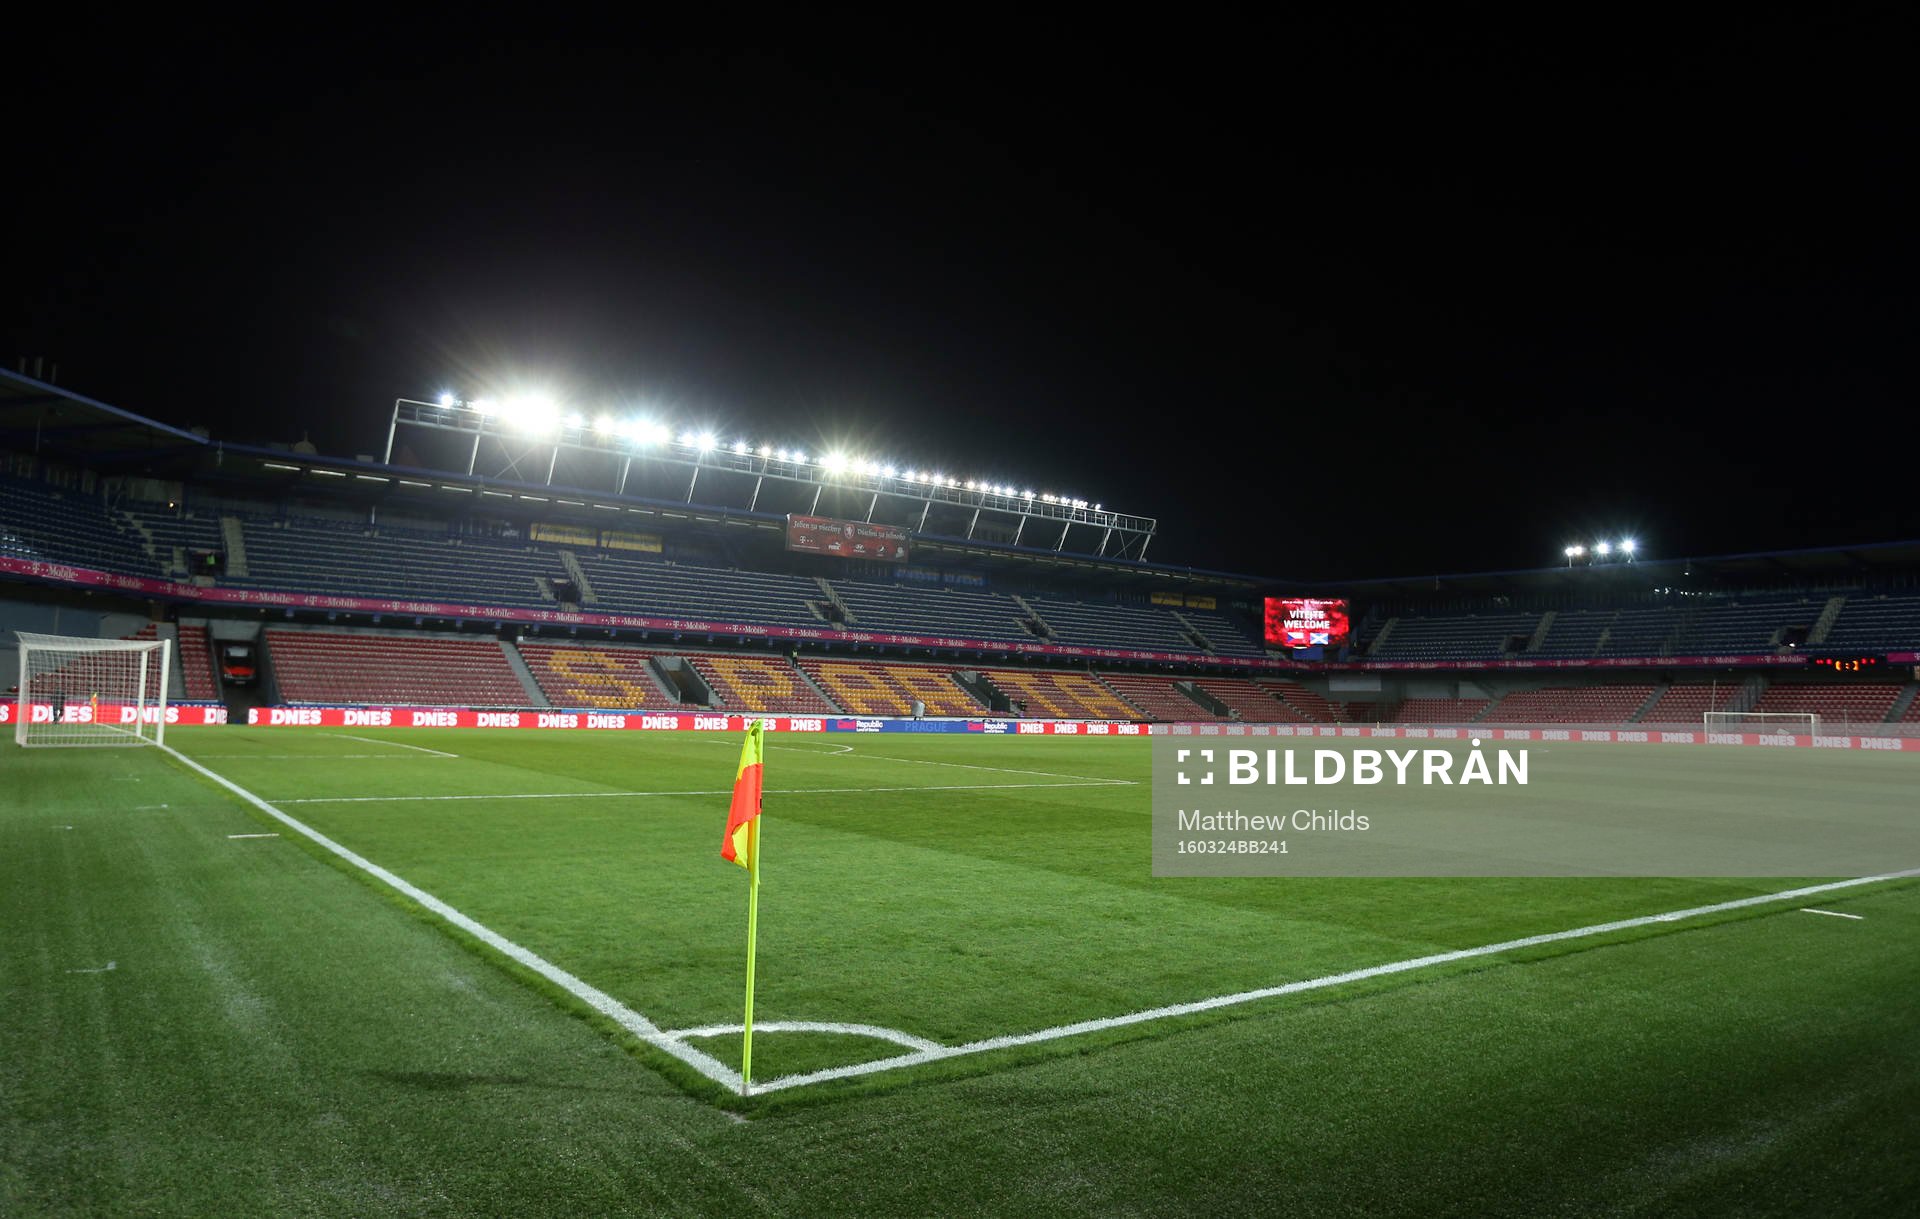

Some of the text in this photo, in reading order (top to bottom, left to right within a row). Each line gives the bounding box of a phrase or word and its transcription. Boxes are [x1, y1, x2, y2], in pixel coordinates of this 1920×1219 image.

[1283, 620, 1330, 630] WELCOME
[270, 709, 322, 725] DNES
[344, 710, 392, 725] DNES
[412, 711, 458, 727] DNES
[477, 712, 520, 727] DNES
[538, 713, 578, 728] DNES
[587, 716, 626, 729] DNES
[642, 716, 679, 729] DNES
[694, 717, 729, 730] DNES
[743, 718, 777, 731] DES
[790, 719, 822, 731] DNES
[905, 722, 947, 732] PRAGUE
[1020, 723, 1044, 733] DNES
[1054, 723, 1077, 734] DNES
[1087, 723, 1109, 734] DNES
[1118, 724, 1139, 734] DNES
[1371, 728, 1396, 737] DNES
[1405, 728, 1429, 738] DNES
[1433, 729, 1457, 738] DNES
[1468, 729, 1492, 739] DNES
[1504, 730, 1530, 739] DNES
[1542, 730, 1569, 740] DNES
[1582, 731, 1610, 741] DNES
[1617, 731, 1648, 742] DNES
[1661, 732, 1694, 743] DNES
[1708, 733, 1743, 744] DNES
[1759, 734, 1796, 745] DNES
[1812, 736, 1851, 747] DNES
[1860, 737, 1902, 749] DNES
